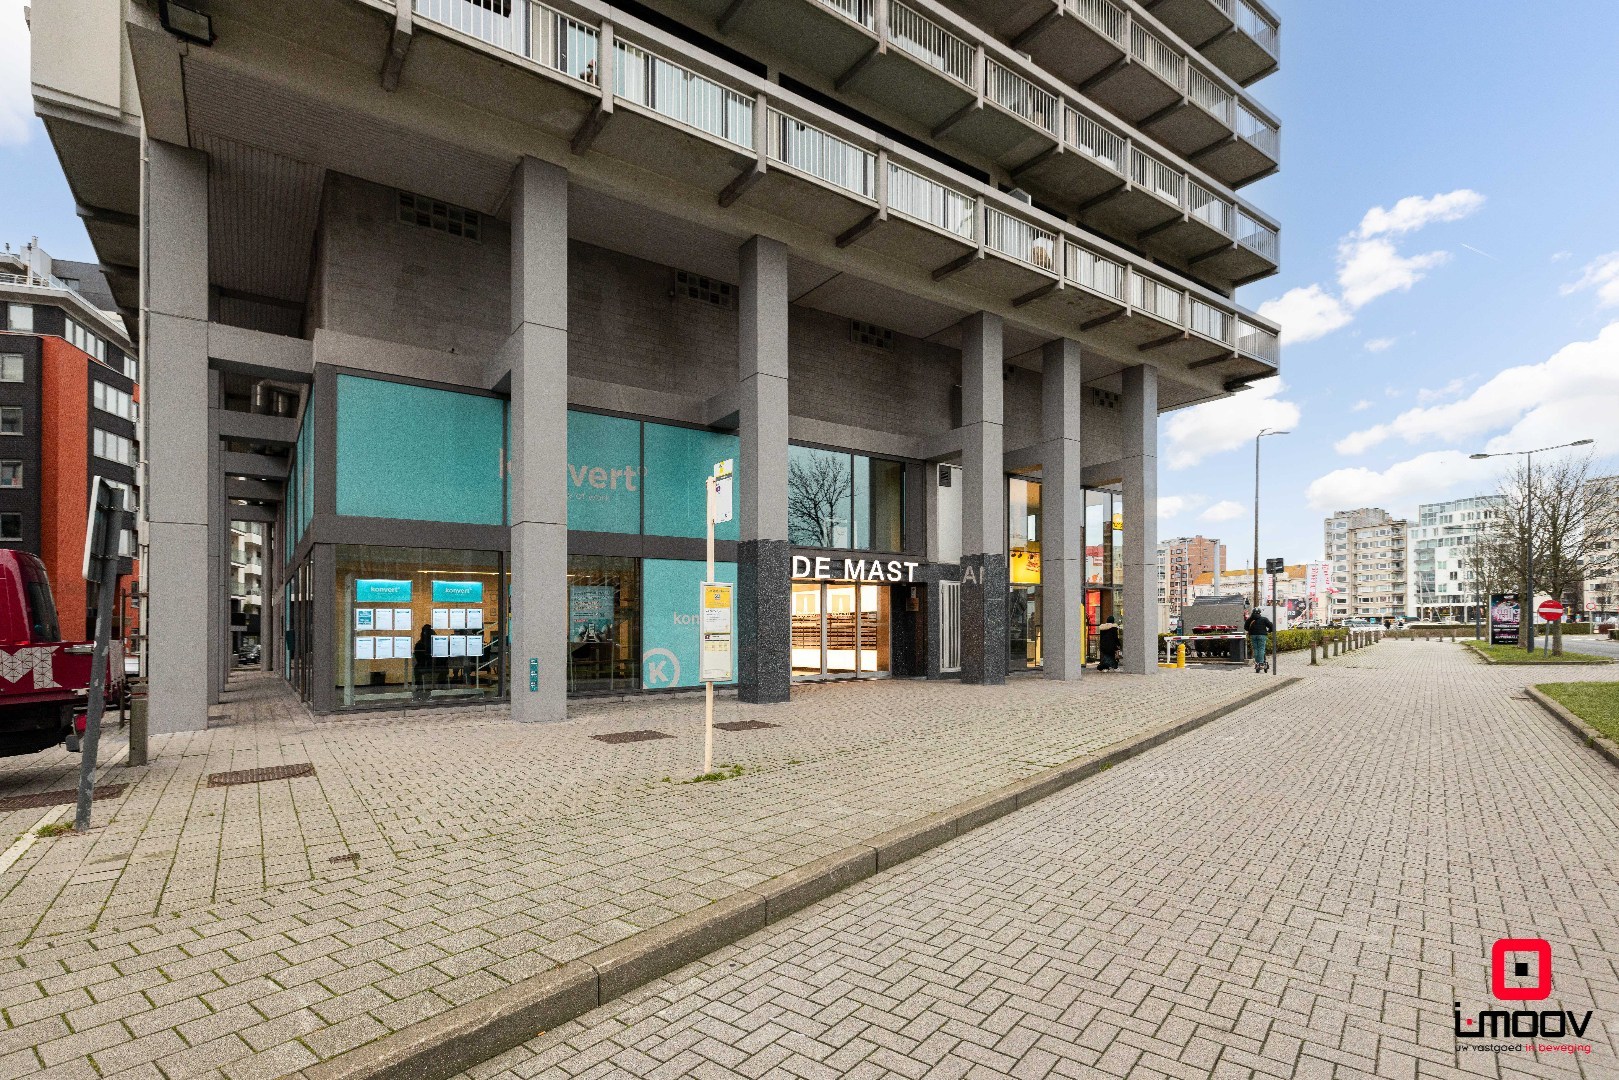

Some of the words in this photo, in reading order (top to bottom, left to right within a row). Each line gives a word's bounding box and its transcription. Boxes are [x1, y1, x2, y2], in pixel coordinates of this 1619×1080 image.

[792, 555, 831, 579] DE
[844, 558, 919, 583] MAST
[370, 585, 399, 593] konvert
